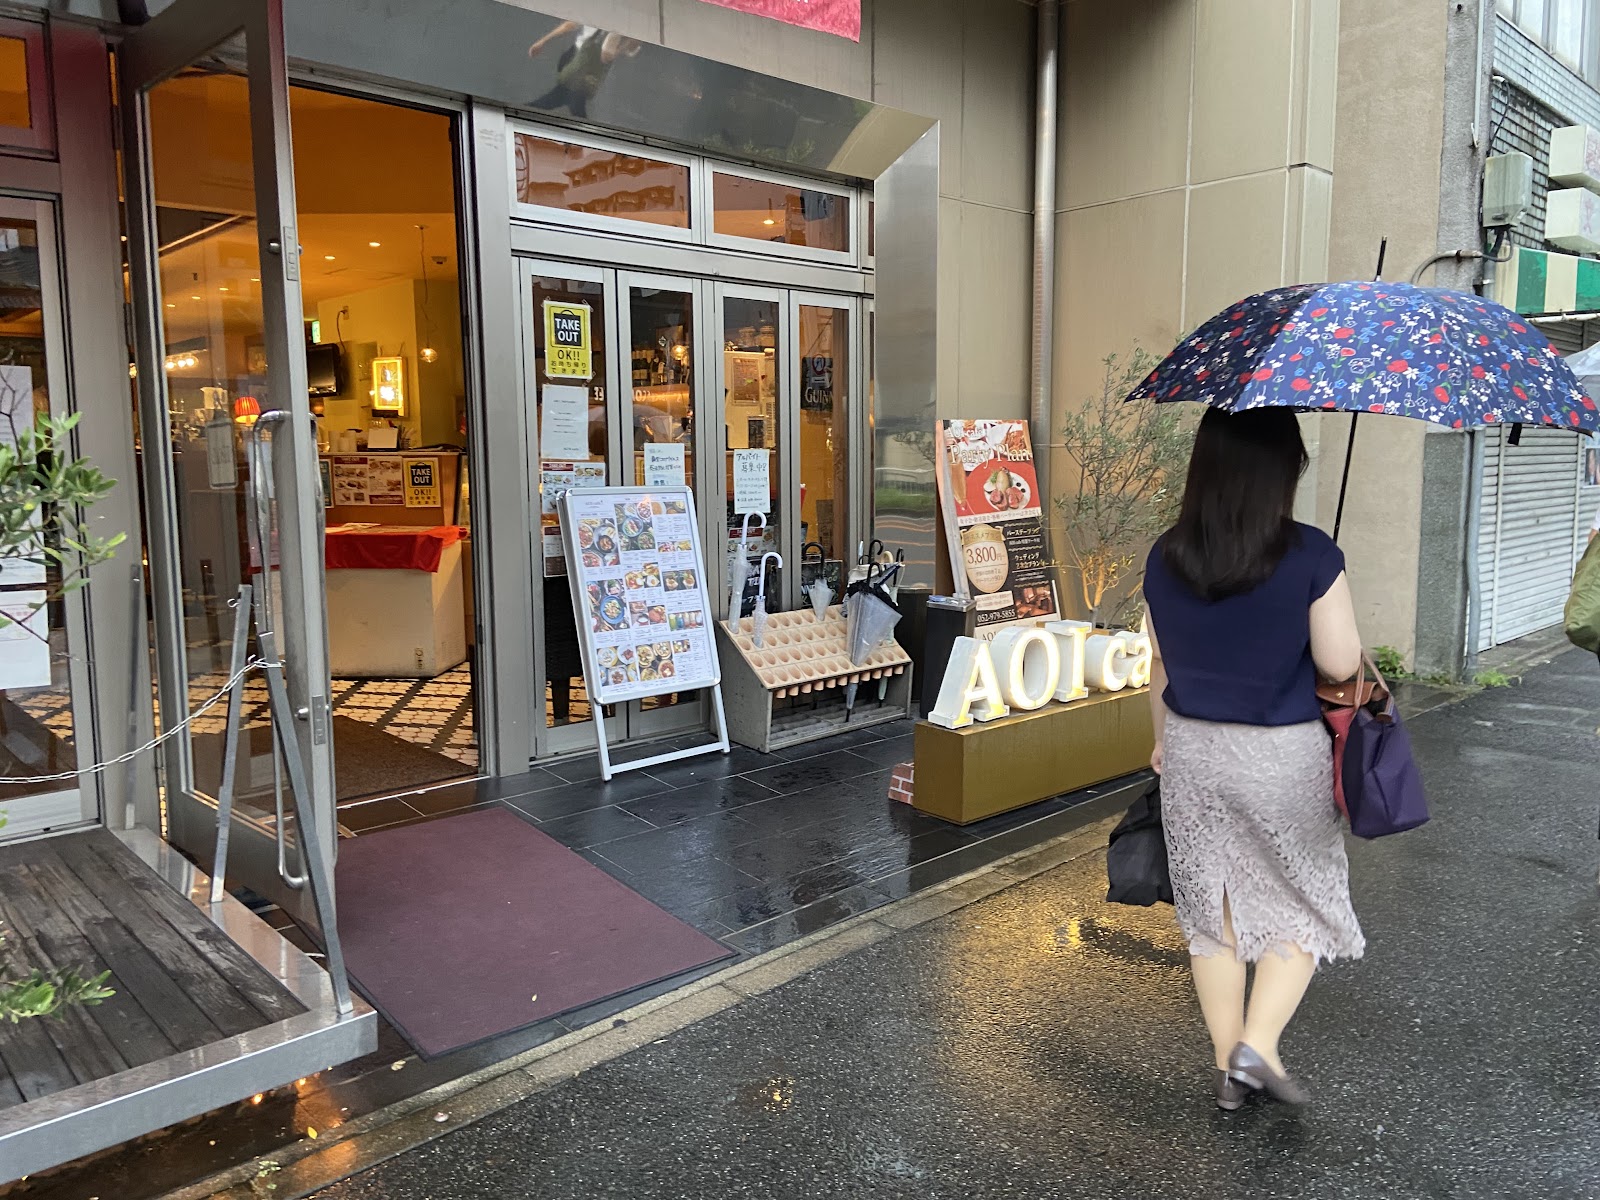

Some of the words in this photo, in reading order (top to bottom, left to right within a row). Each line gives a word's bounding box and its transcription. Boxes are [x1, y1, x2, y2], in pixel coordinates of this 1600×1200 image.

[554, 318, 580, 330] TAKE
[557, 330, 578, 342] OUT
[557, 349, 580, 360] OK!!
[950, 443, 992, 469] Party
[994, 443, 1031, 462] Plan
[411, 468, 431, 476] TAKE
[413, 475, 430, 484] OUT
[413, 488, 432, 496] OK!!
[977, 608, 1016, 623] 052-979-5855
[928, 620, 1092, 729] AOI
